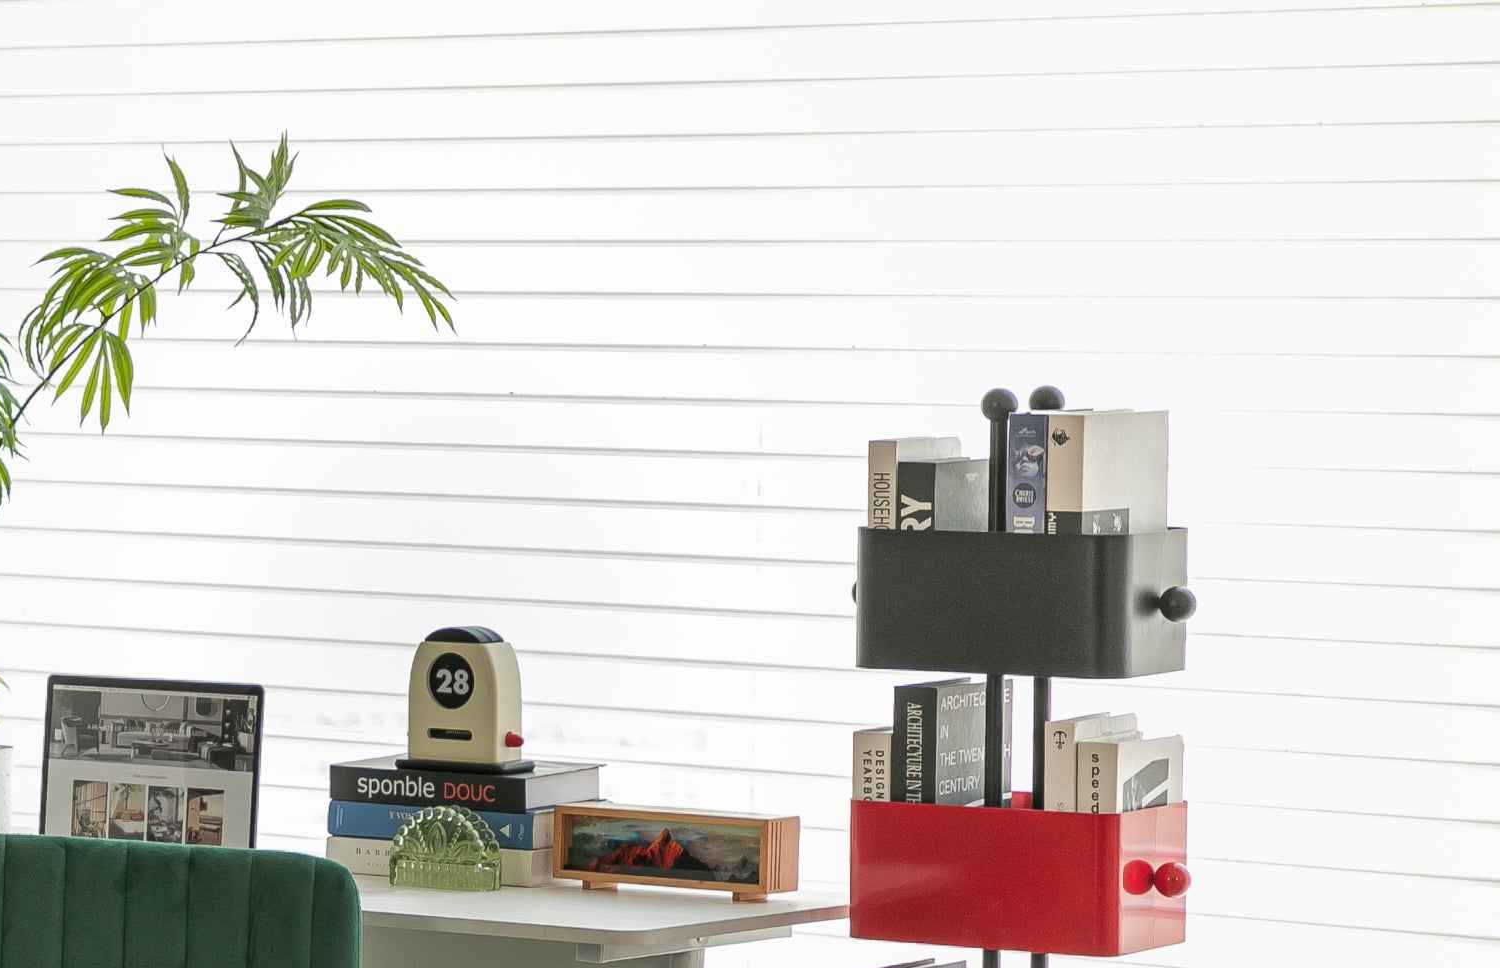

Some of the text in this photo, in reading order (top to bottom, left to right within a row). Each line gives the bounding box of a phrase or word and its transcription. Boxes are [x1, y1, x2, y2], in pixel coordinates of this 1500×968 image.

[436, 668, 470, 696] 28
[940, 688, 1010, 713] ARCHITECE
[940, 725, 949, 739] IN
[940, 750, 957, 767] THE
[875, 750, 885, 799] DESIGN
[938, 775, 981, 796] CENTURY
[1091, 753, 1100, 814] speed
[357, 776, 496, 802] sponble DOUC
